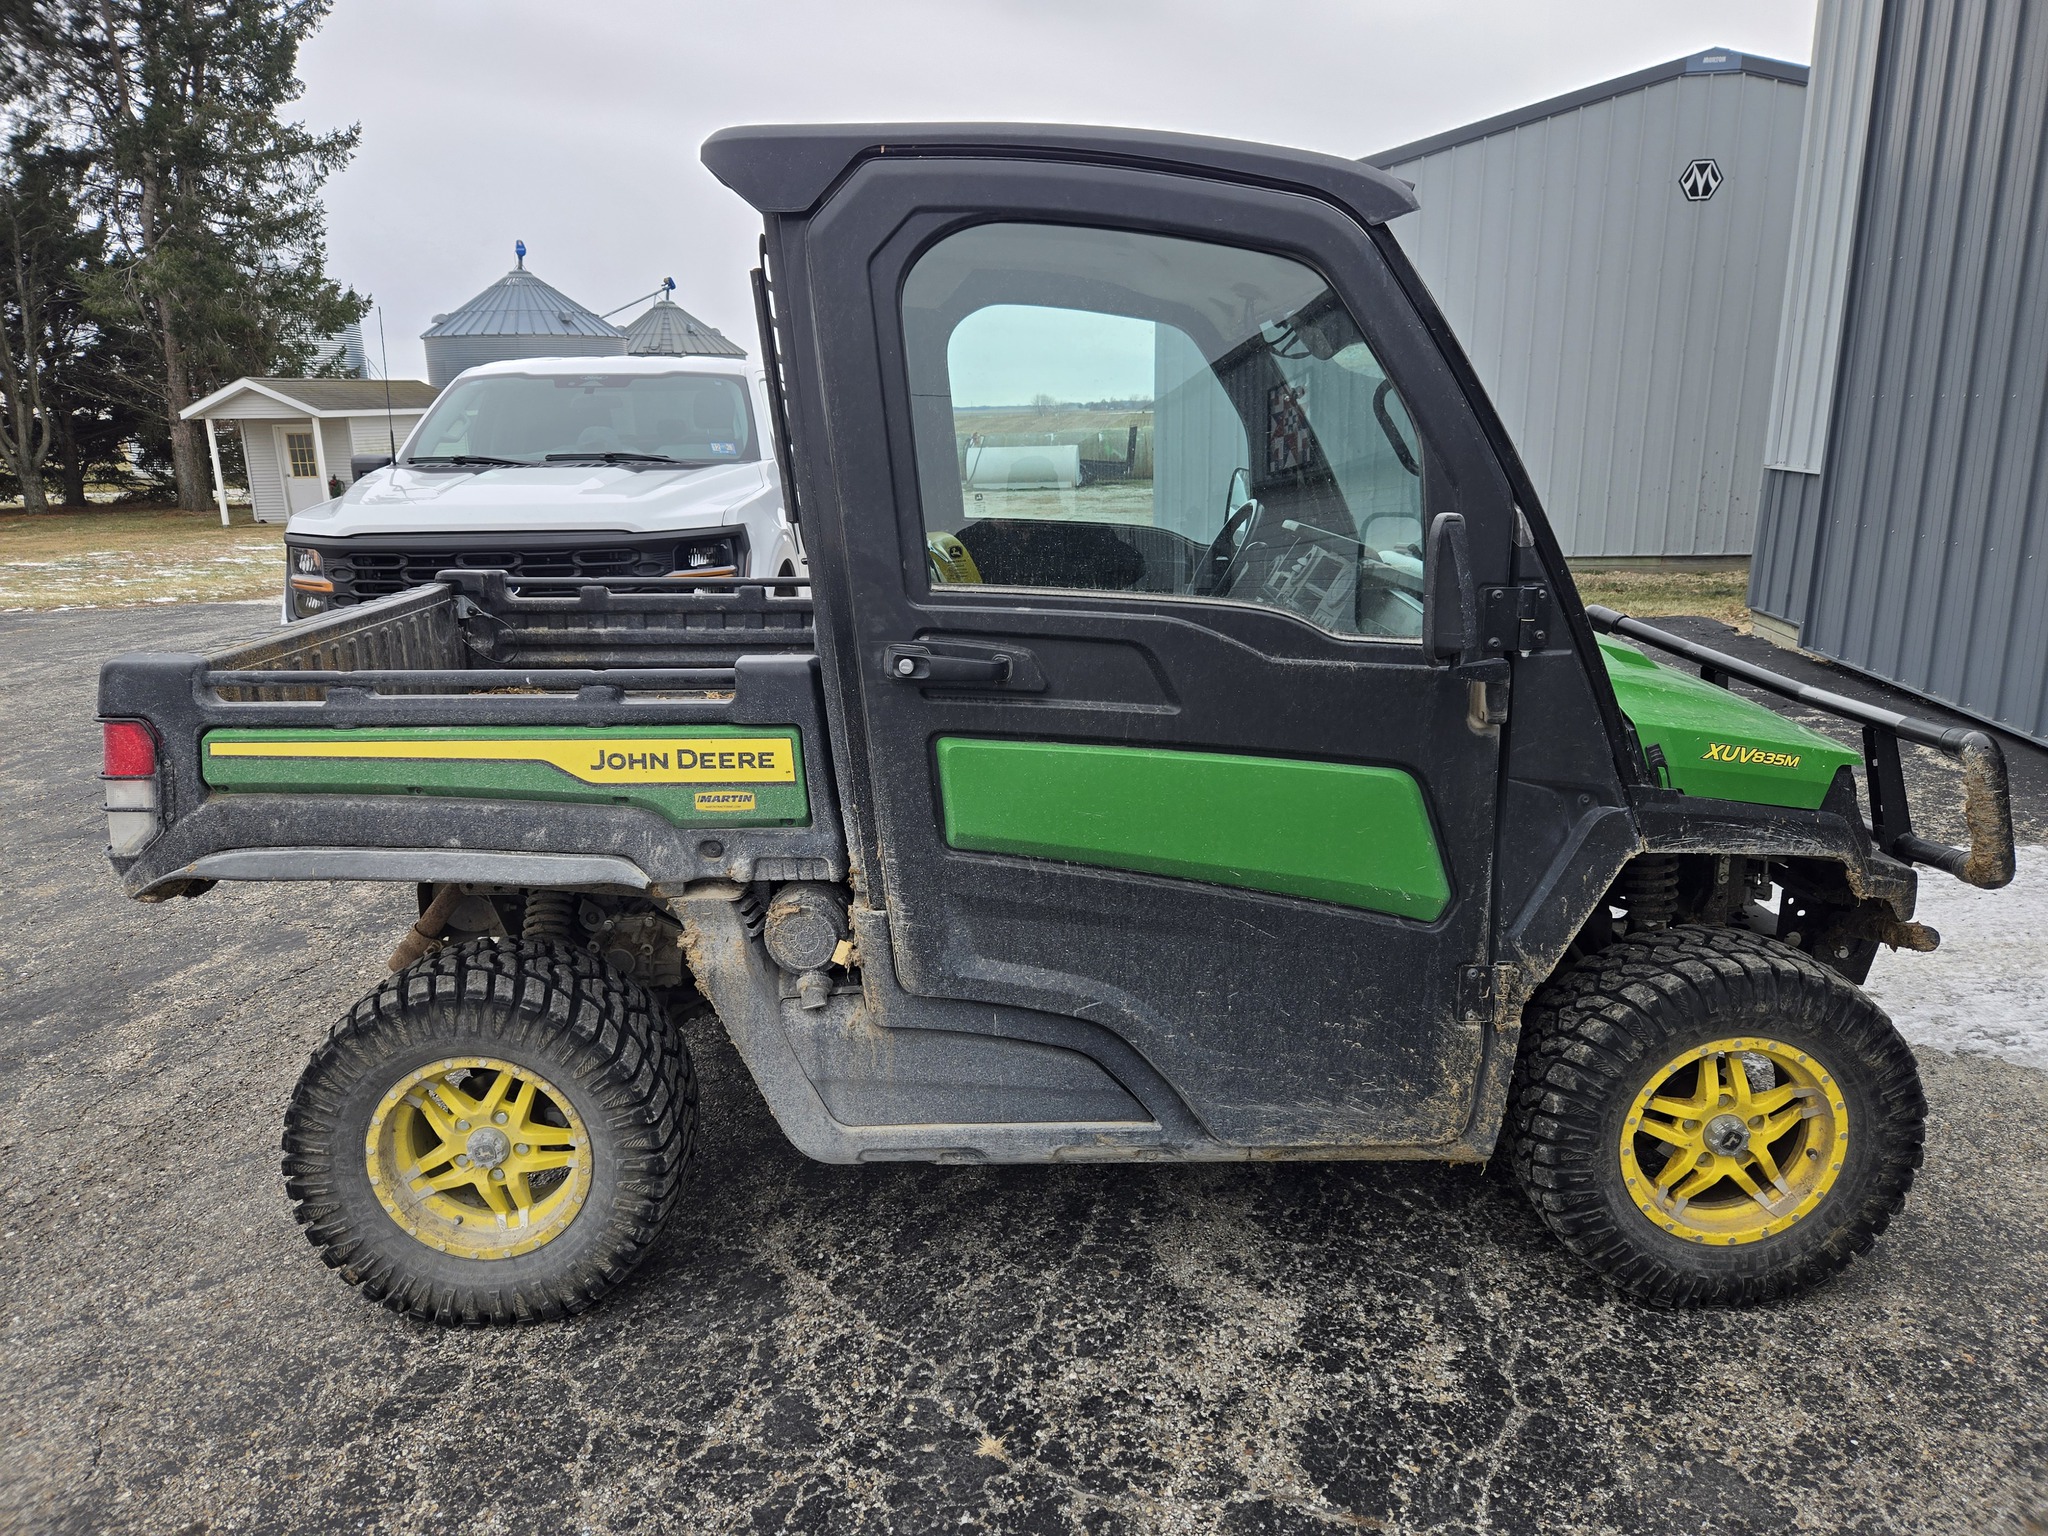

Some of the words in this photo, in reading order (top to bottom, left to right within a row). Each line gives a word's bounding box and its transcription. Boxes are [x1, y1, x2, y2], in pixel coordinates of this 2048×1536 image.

[590, 749, 668, 771] JOHN
[676, 748, 775, 770] DEERE
[1700, 742, 1801, 768] XUV835M
[698, 795, 753, 803] MARTIN
